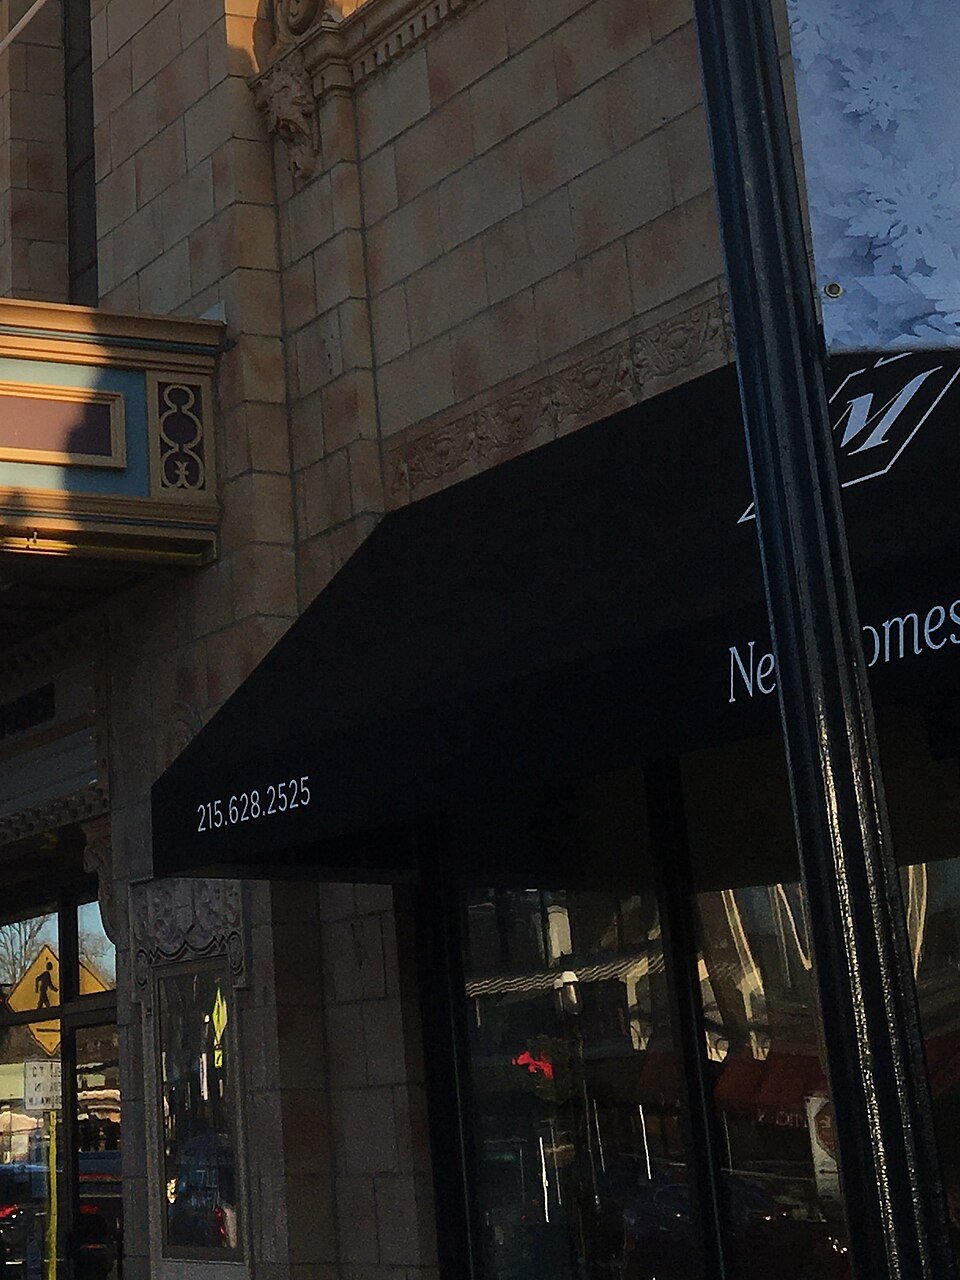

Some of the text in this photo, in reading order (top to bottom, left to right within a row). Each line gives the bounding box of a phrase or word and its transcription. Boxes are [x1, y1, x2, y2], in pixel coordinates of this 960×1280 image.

[728, 599, 960, 703] Ne omes
[197, 775, 311, 832] 215.628.2525
